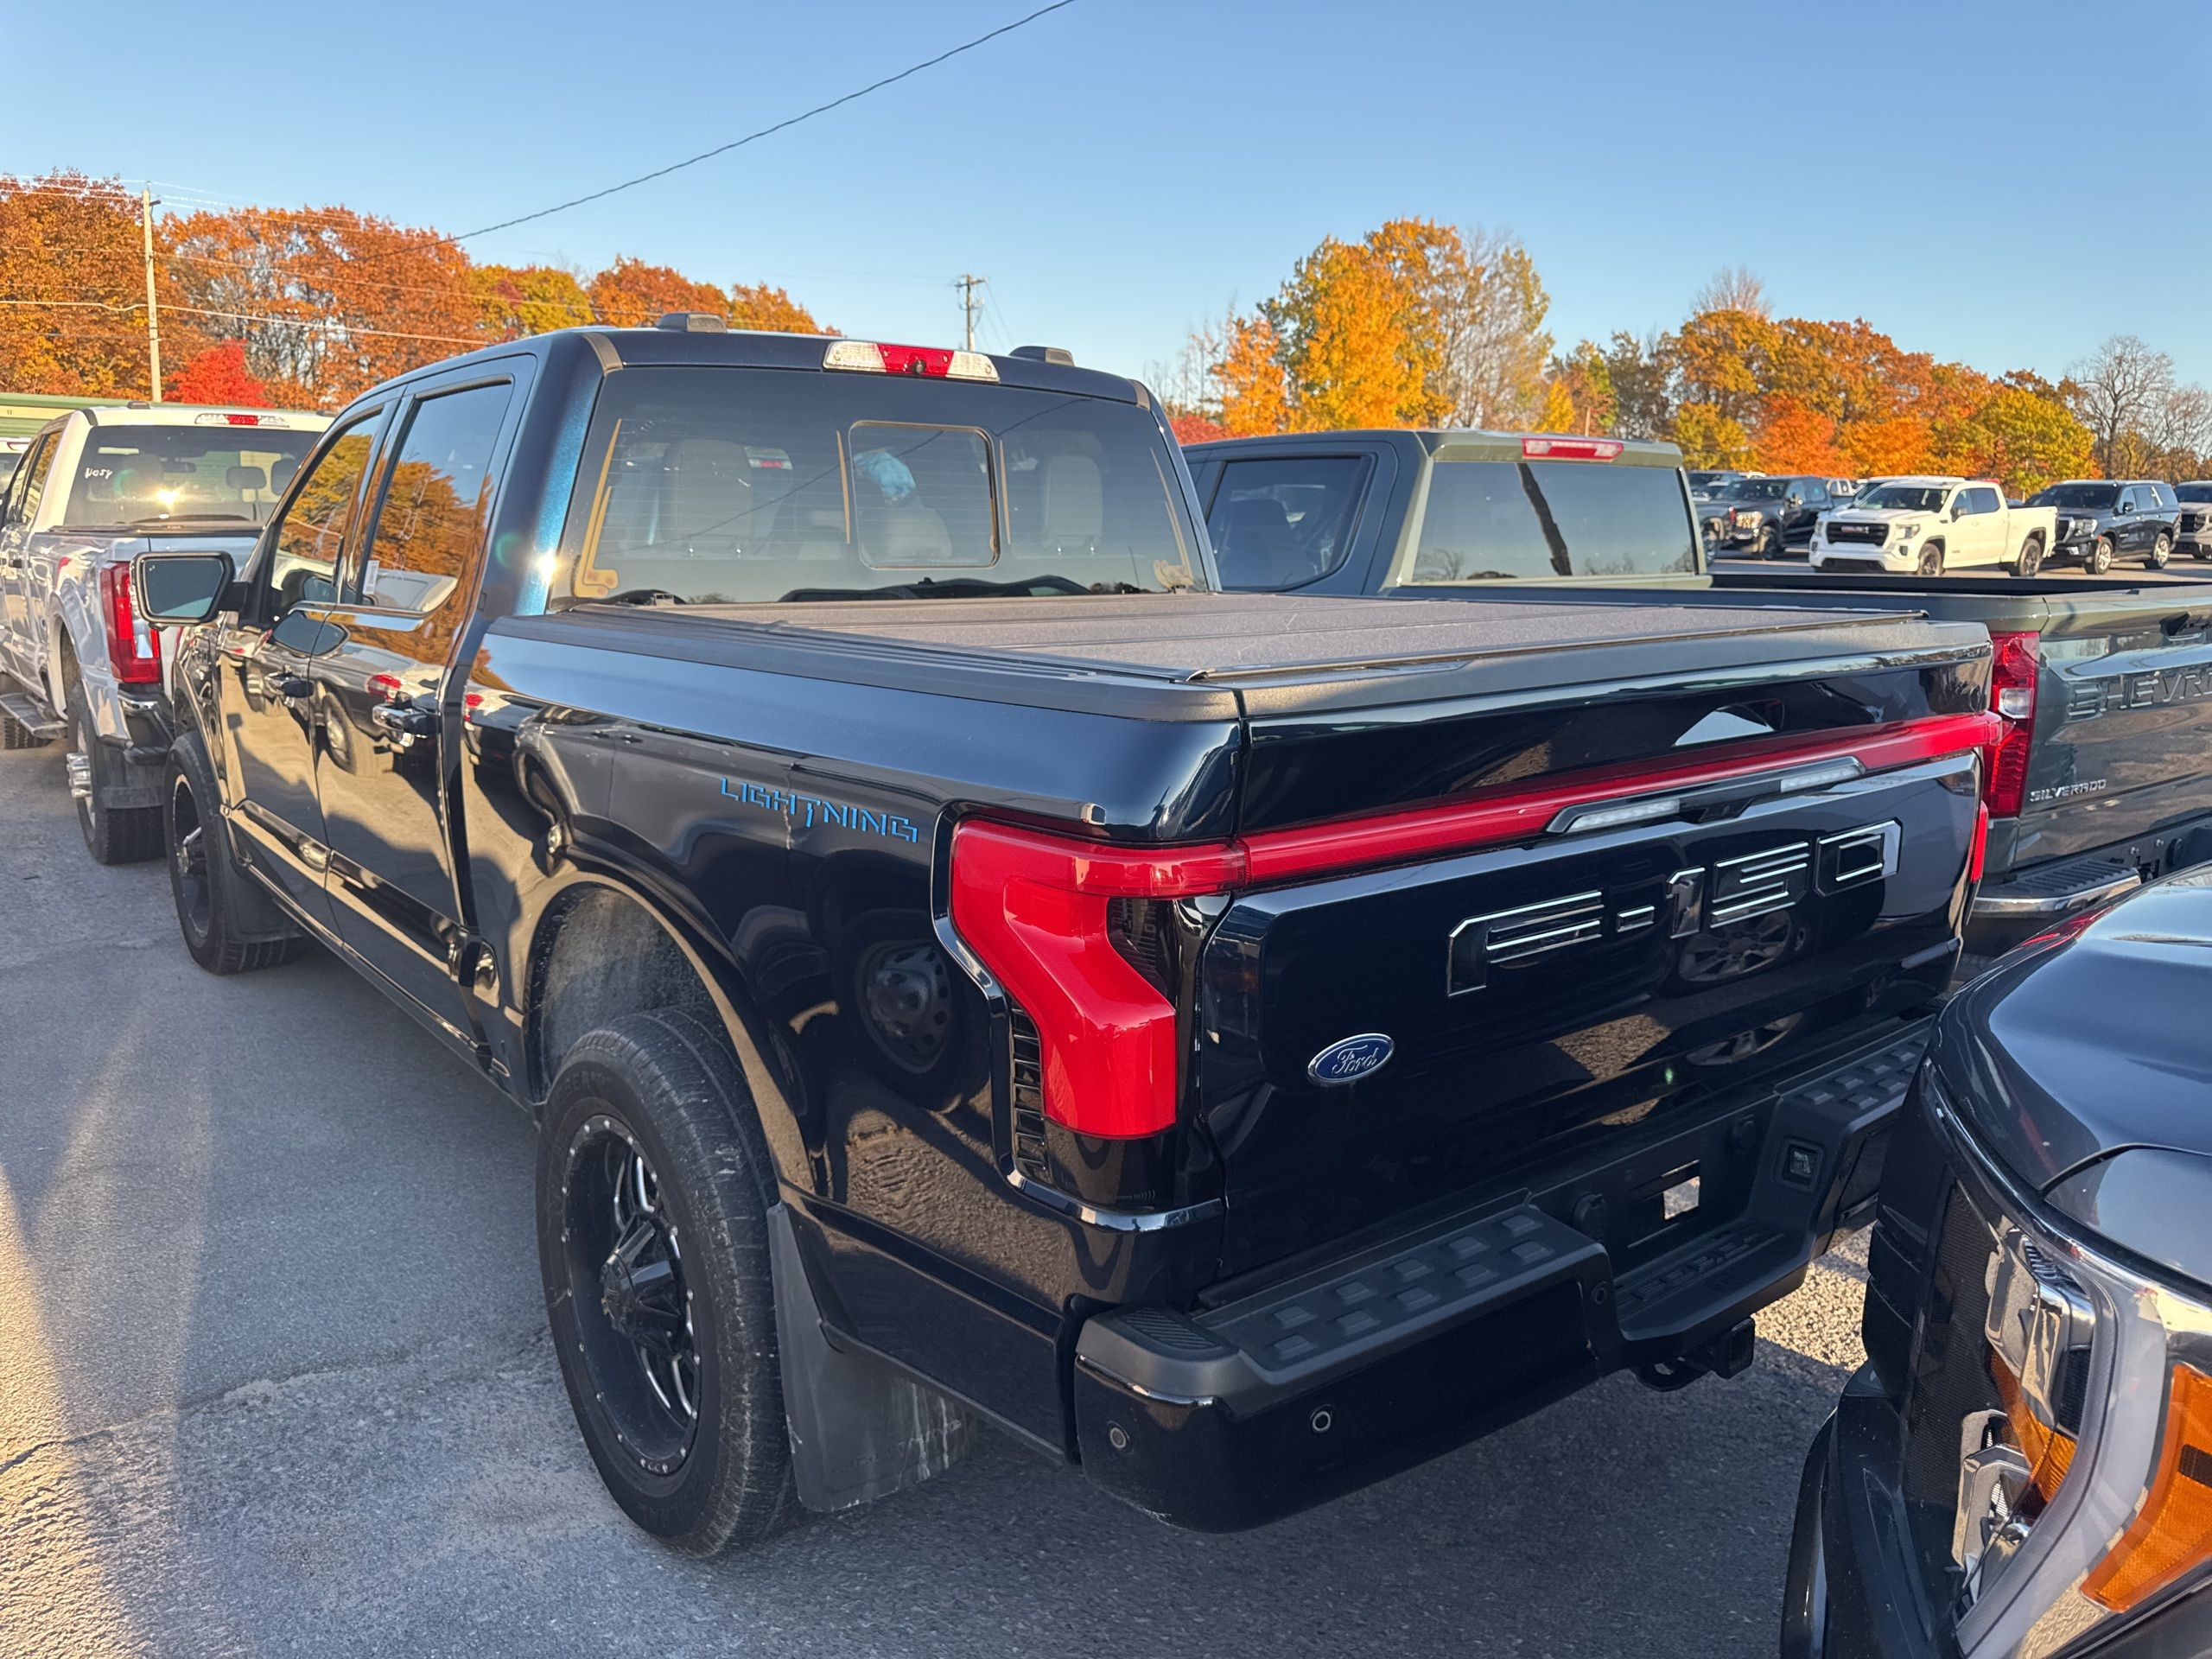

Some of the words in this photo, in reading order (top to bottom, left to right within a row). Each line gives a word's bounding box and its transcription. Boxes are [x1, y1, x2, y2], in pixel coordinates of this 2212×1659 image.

[720, 777, 918, 843] LIGHTNING
[2030, 779, 2107, 803] SILVERADO
[1447, 817, 1903, 996] F-150
[1332, 1044, 1380, 1074] Ford
